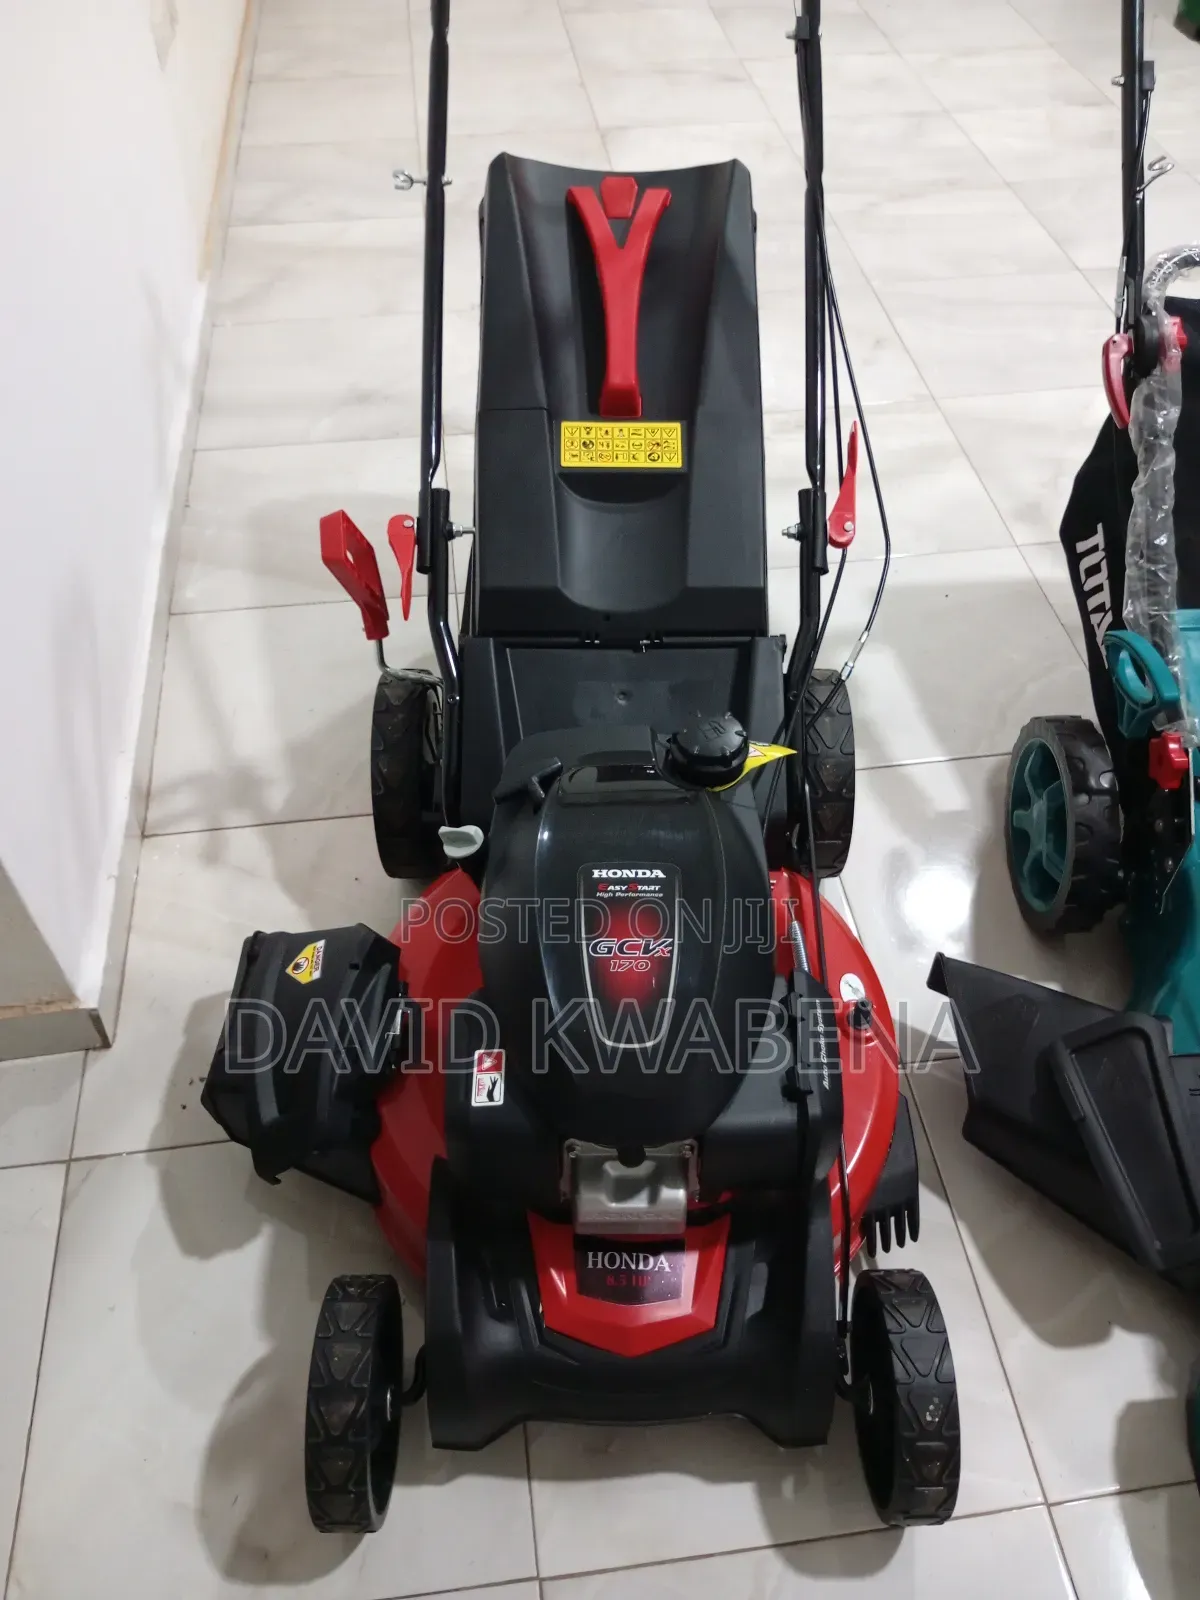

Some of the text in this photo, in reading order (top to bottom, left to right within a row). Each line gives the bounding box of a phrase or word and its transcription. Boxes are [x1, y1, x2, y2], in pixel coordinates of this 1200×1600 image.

[592, 869, 667, 878] HONDA
[609, 959, 651, 972] 170
[816, 999, 830, 1090] Auto Choke System
[586, 1251, 672, 1273] HONDA
